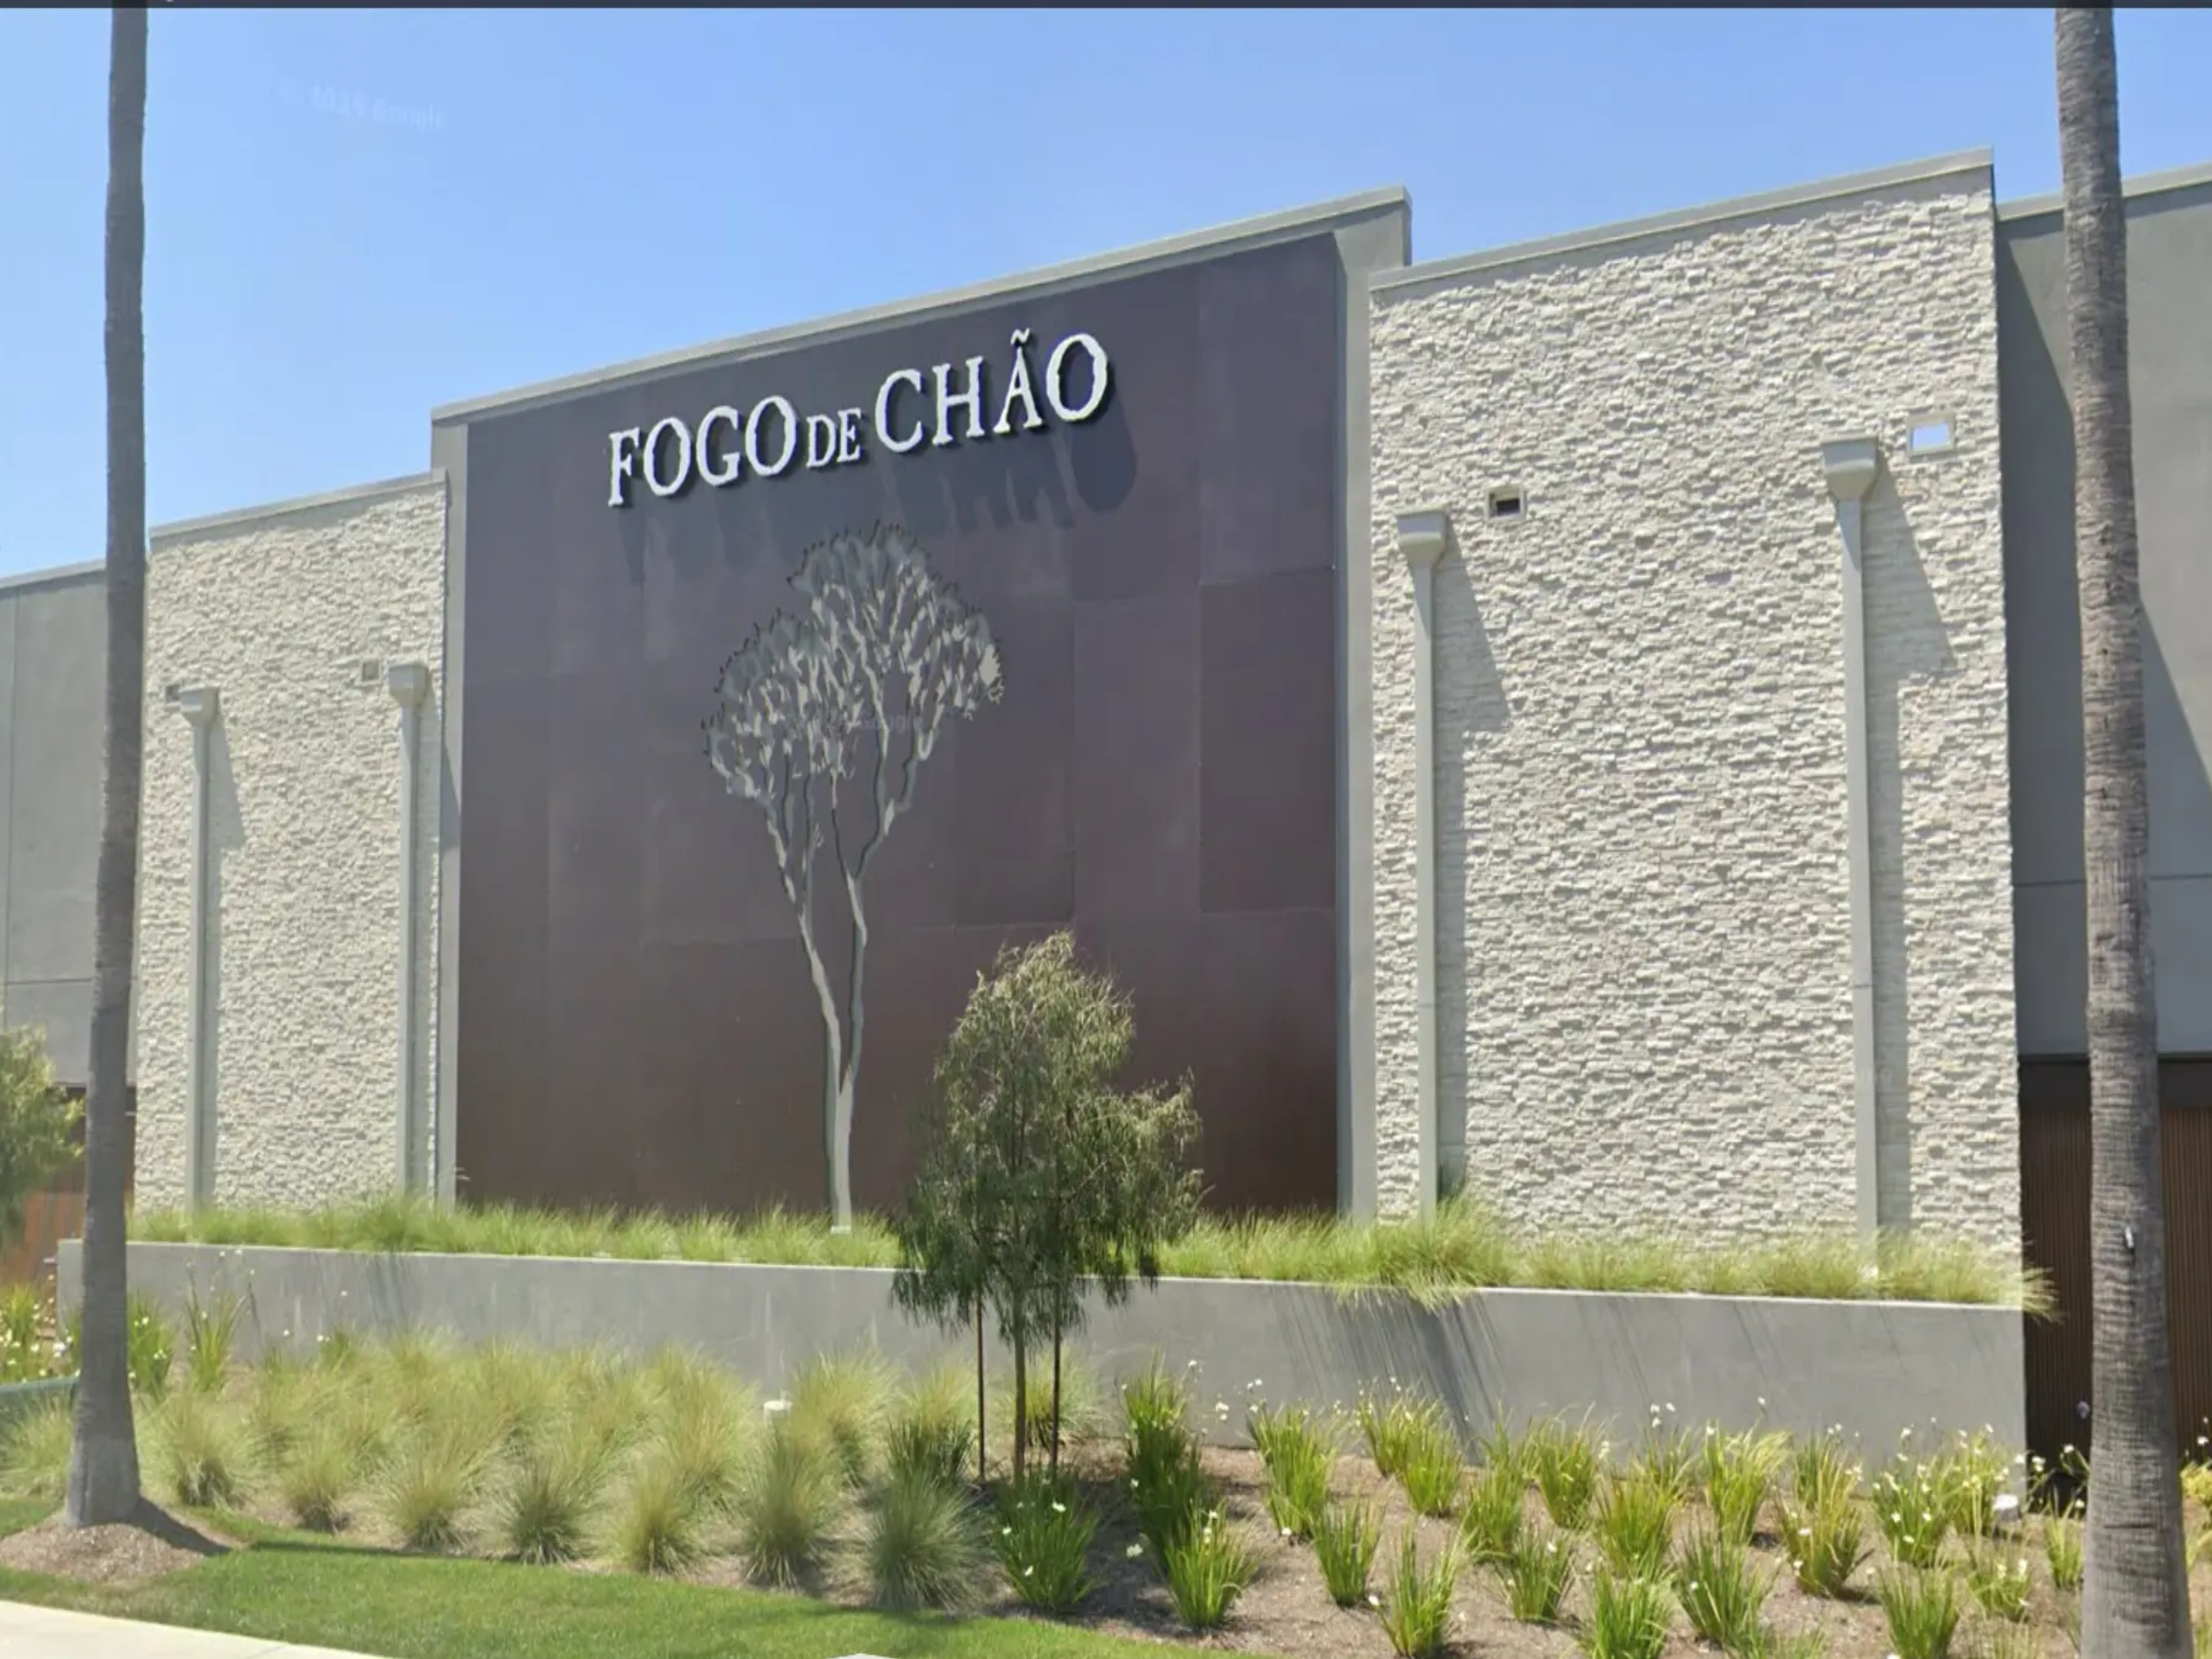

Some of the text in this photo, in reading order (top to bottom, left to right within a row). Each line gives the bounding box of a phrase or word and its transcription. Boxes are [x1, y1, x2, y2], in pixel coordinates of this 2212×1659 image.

[607, 328, 1109, 506] FOGO DE CHÃO
